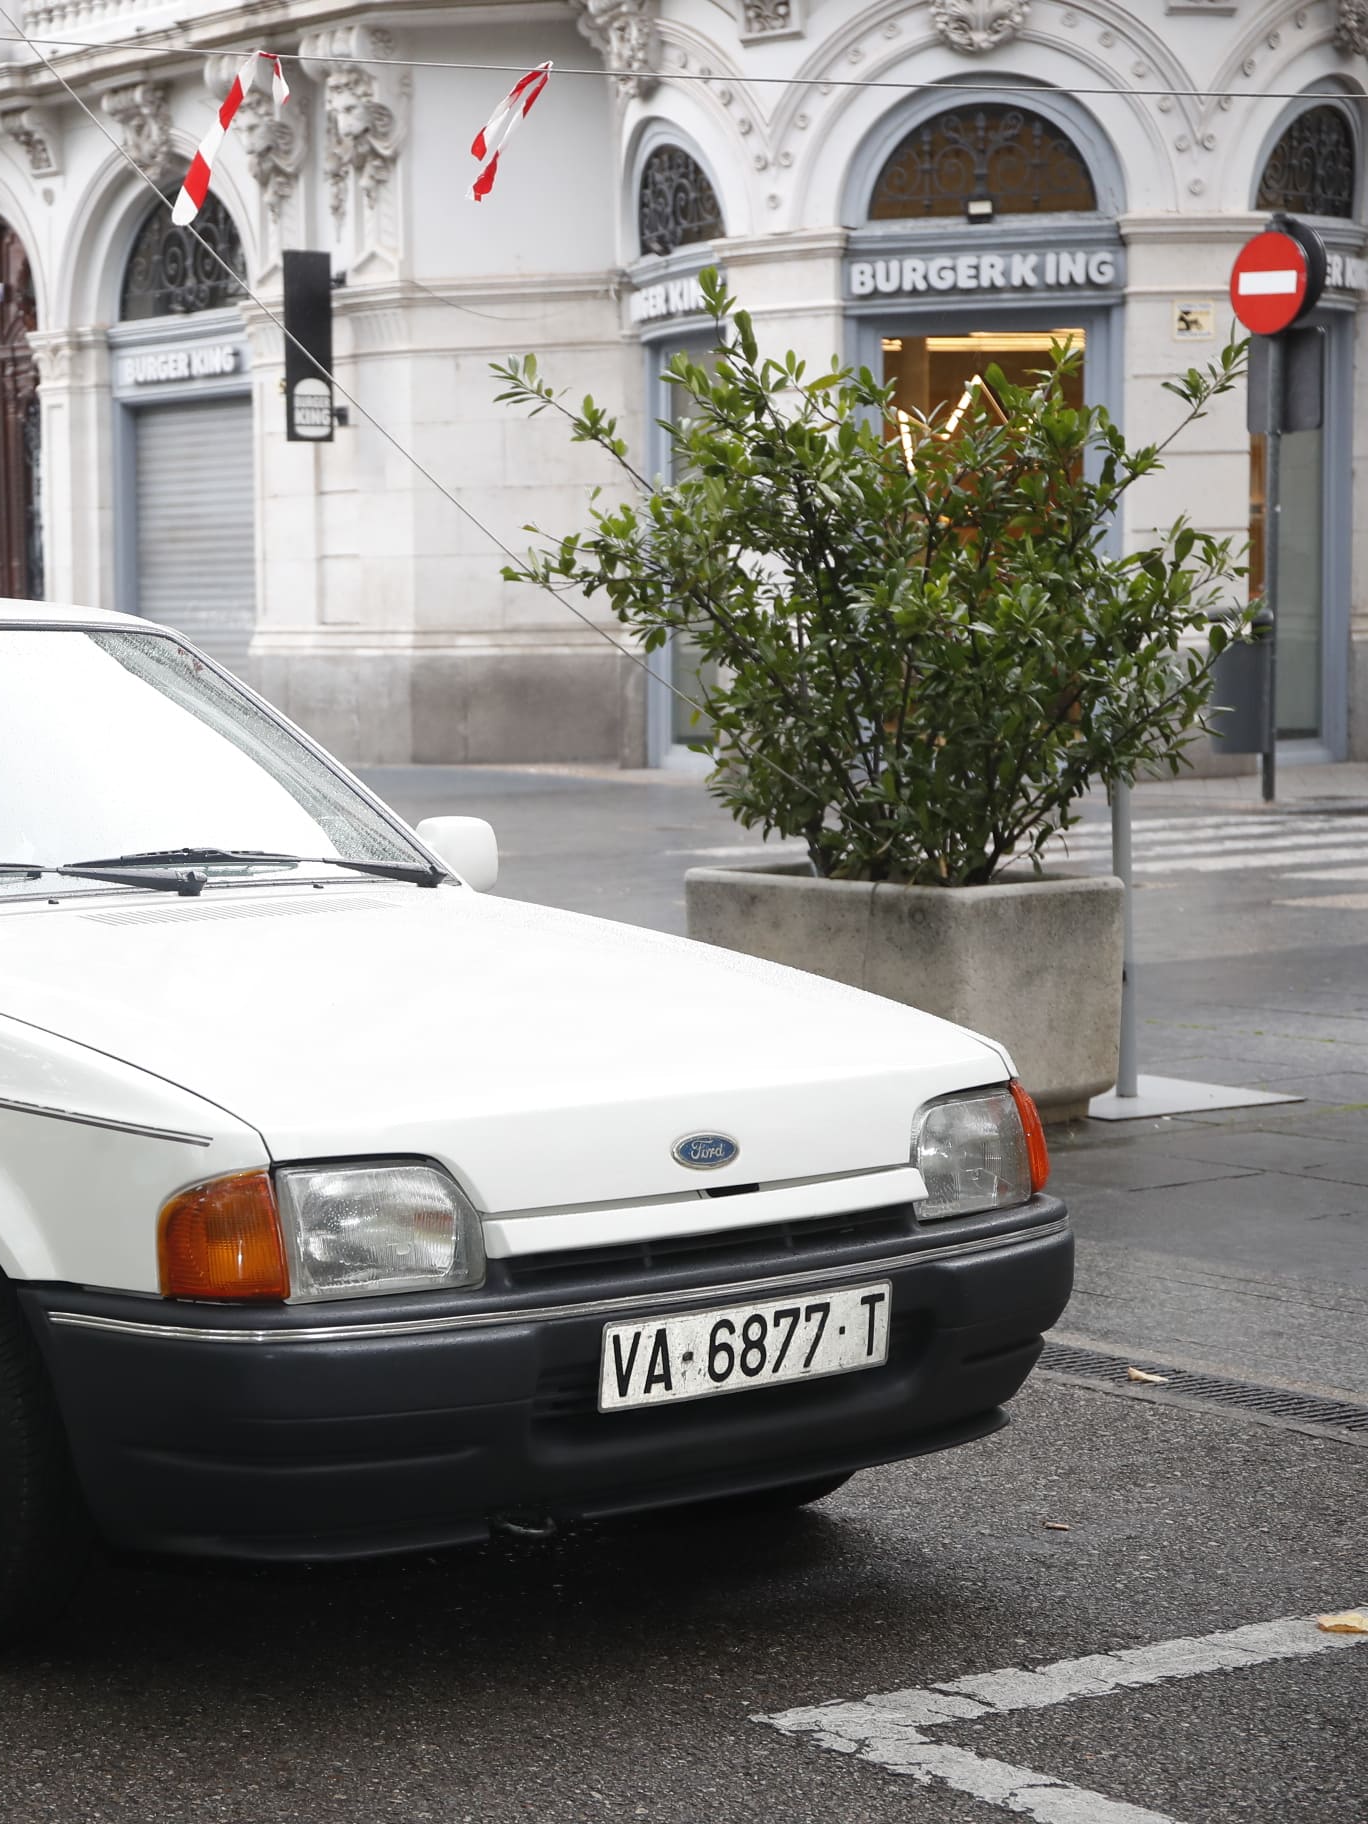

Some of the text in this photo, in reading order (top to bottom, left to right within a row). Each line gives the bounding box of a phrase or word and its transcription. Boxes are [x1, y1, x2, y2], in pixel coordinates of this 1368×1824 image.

[850, 251, 1116, 296] BURGER KING
[668, 275, 721, 313] KIN
[125, 346, 236, 384] BURGER KING
[294, 408, 331, 426] KING
[689, 1138, 725, 1160] Ford
